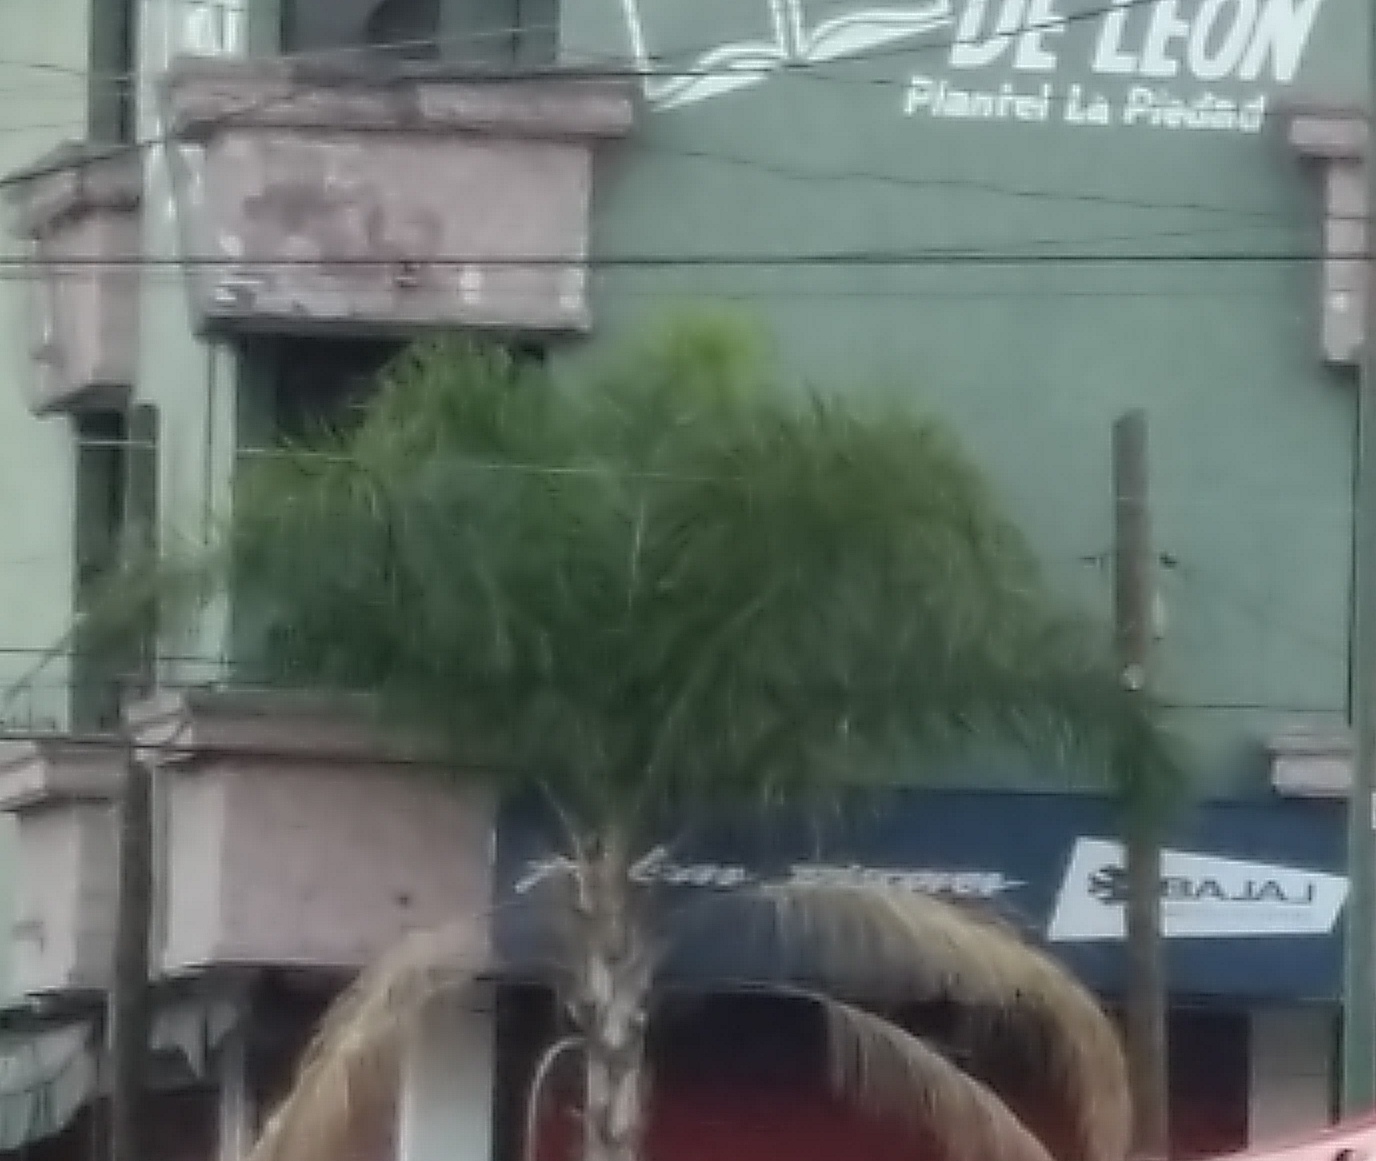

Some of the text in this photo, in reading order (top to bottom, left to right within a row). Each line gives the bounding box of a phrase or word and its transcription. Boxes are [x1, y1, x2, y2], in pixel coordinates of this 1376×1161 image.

[948, 0, 1067, 69] DE
[903, 75, 1265, 133] Plantel La Piedad
